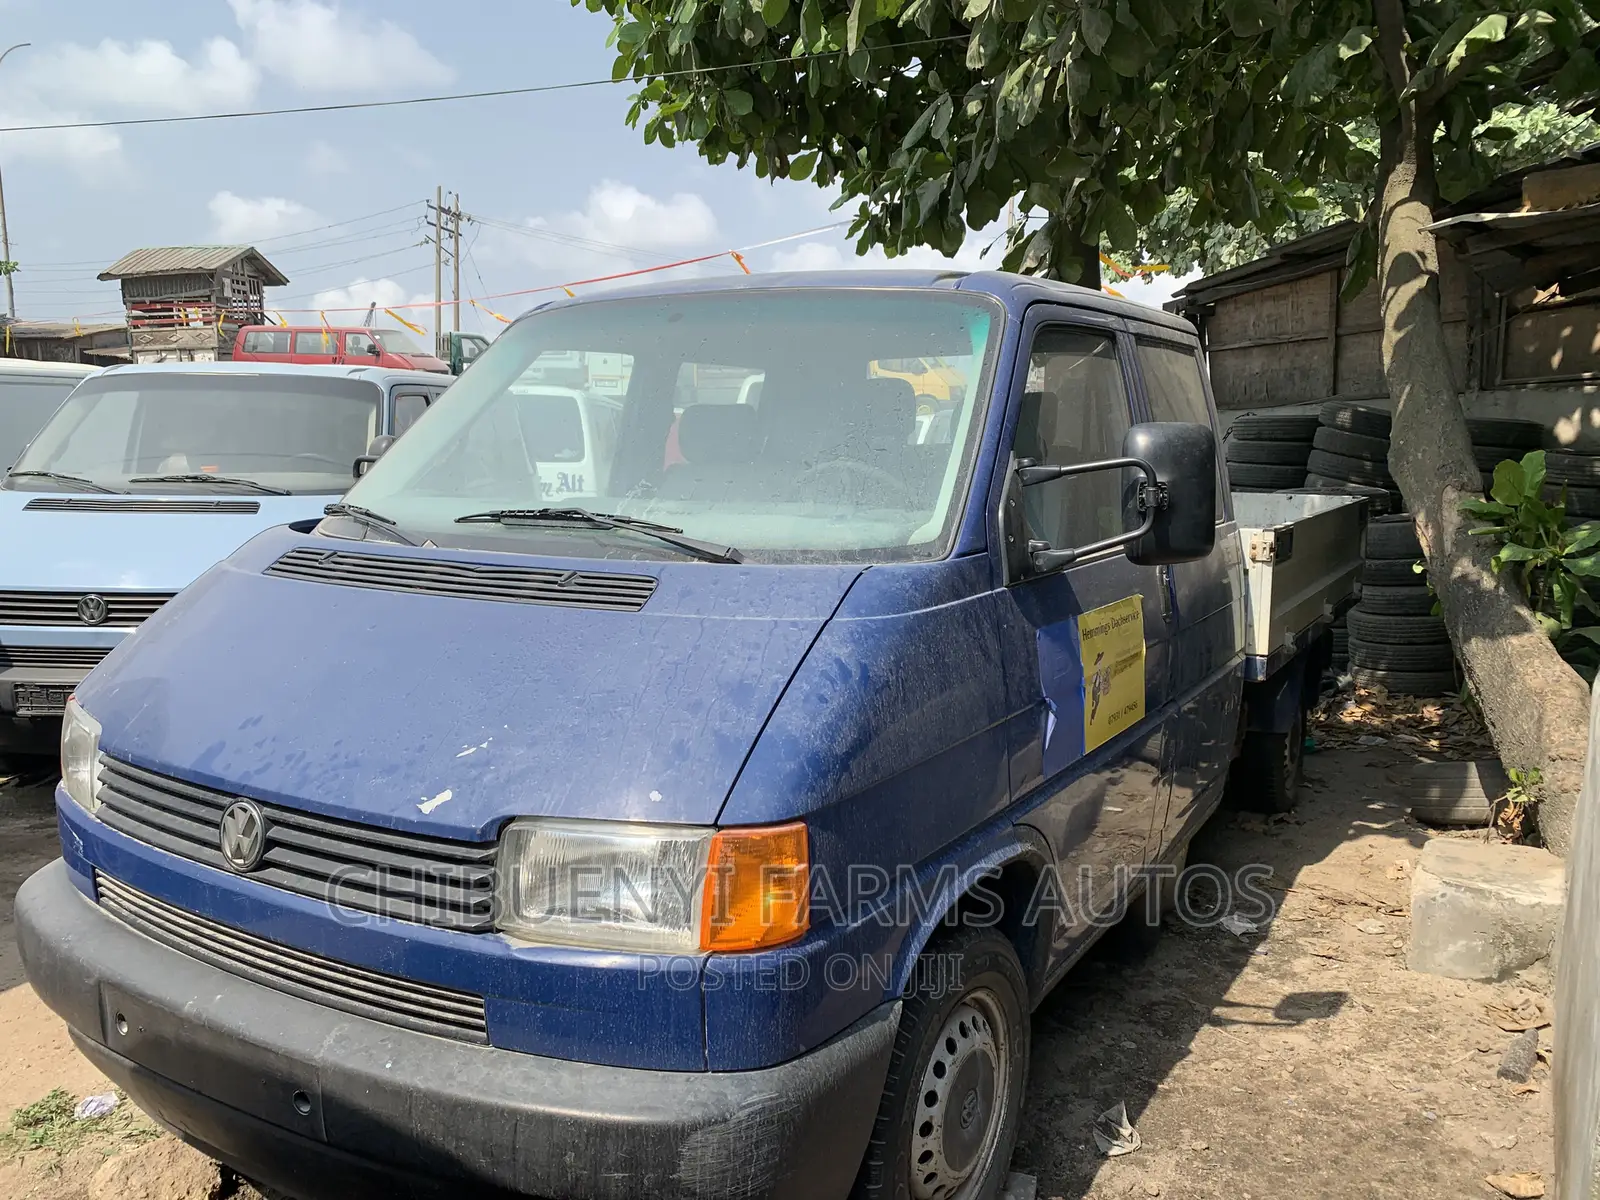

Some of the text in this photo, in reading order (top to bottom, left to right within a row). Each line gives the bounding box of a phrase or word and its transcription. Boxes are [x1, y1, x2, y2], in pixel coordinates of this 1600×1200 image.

[556, 472, 584, 494] Alt
[1082, 622, 1110, 641] Hemmings
[220, 798, 266, 872] VW
